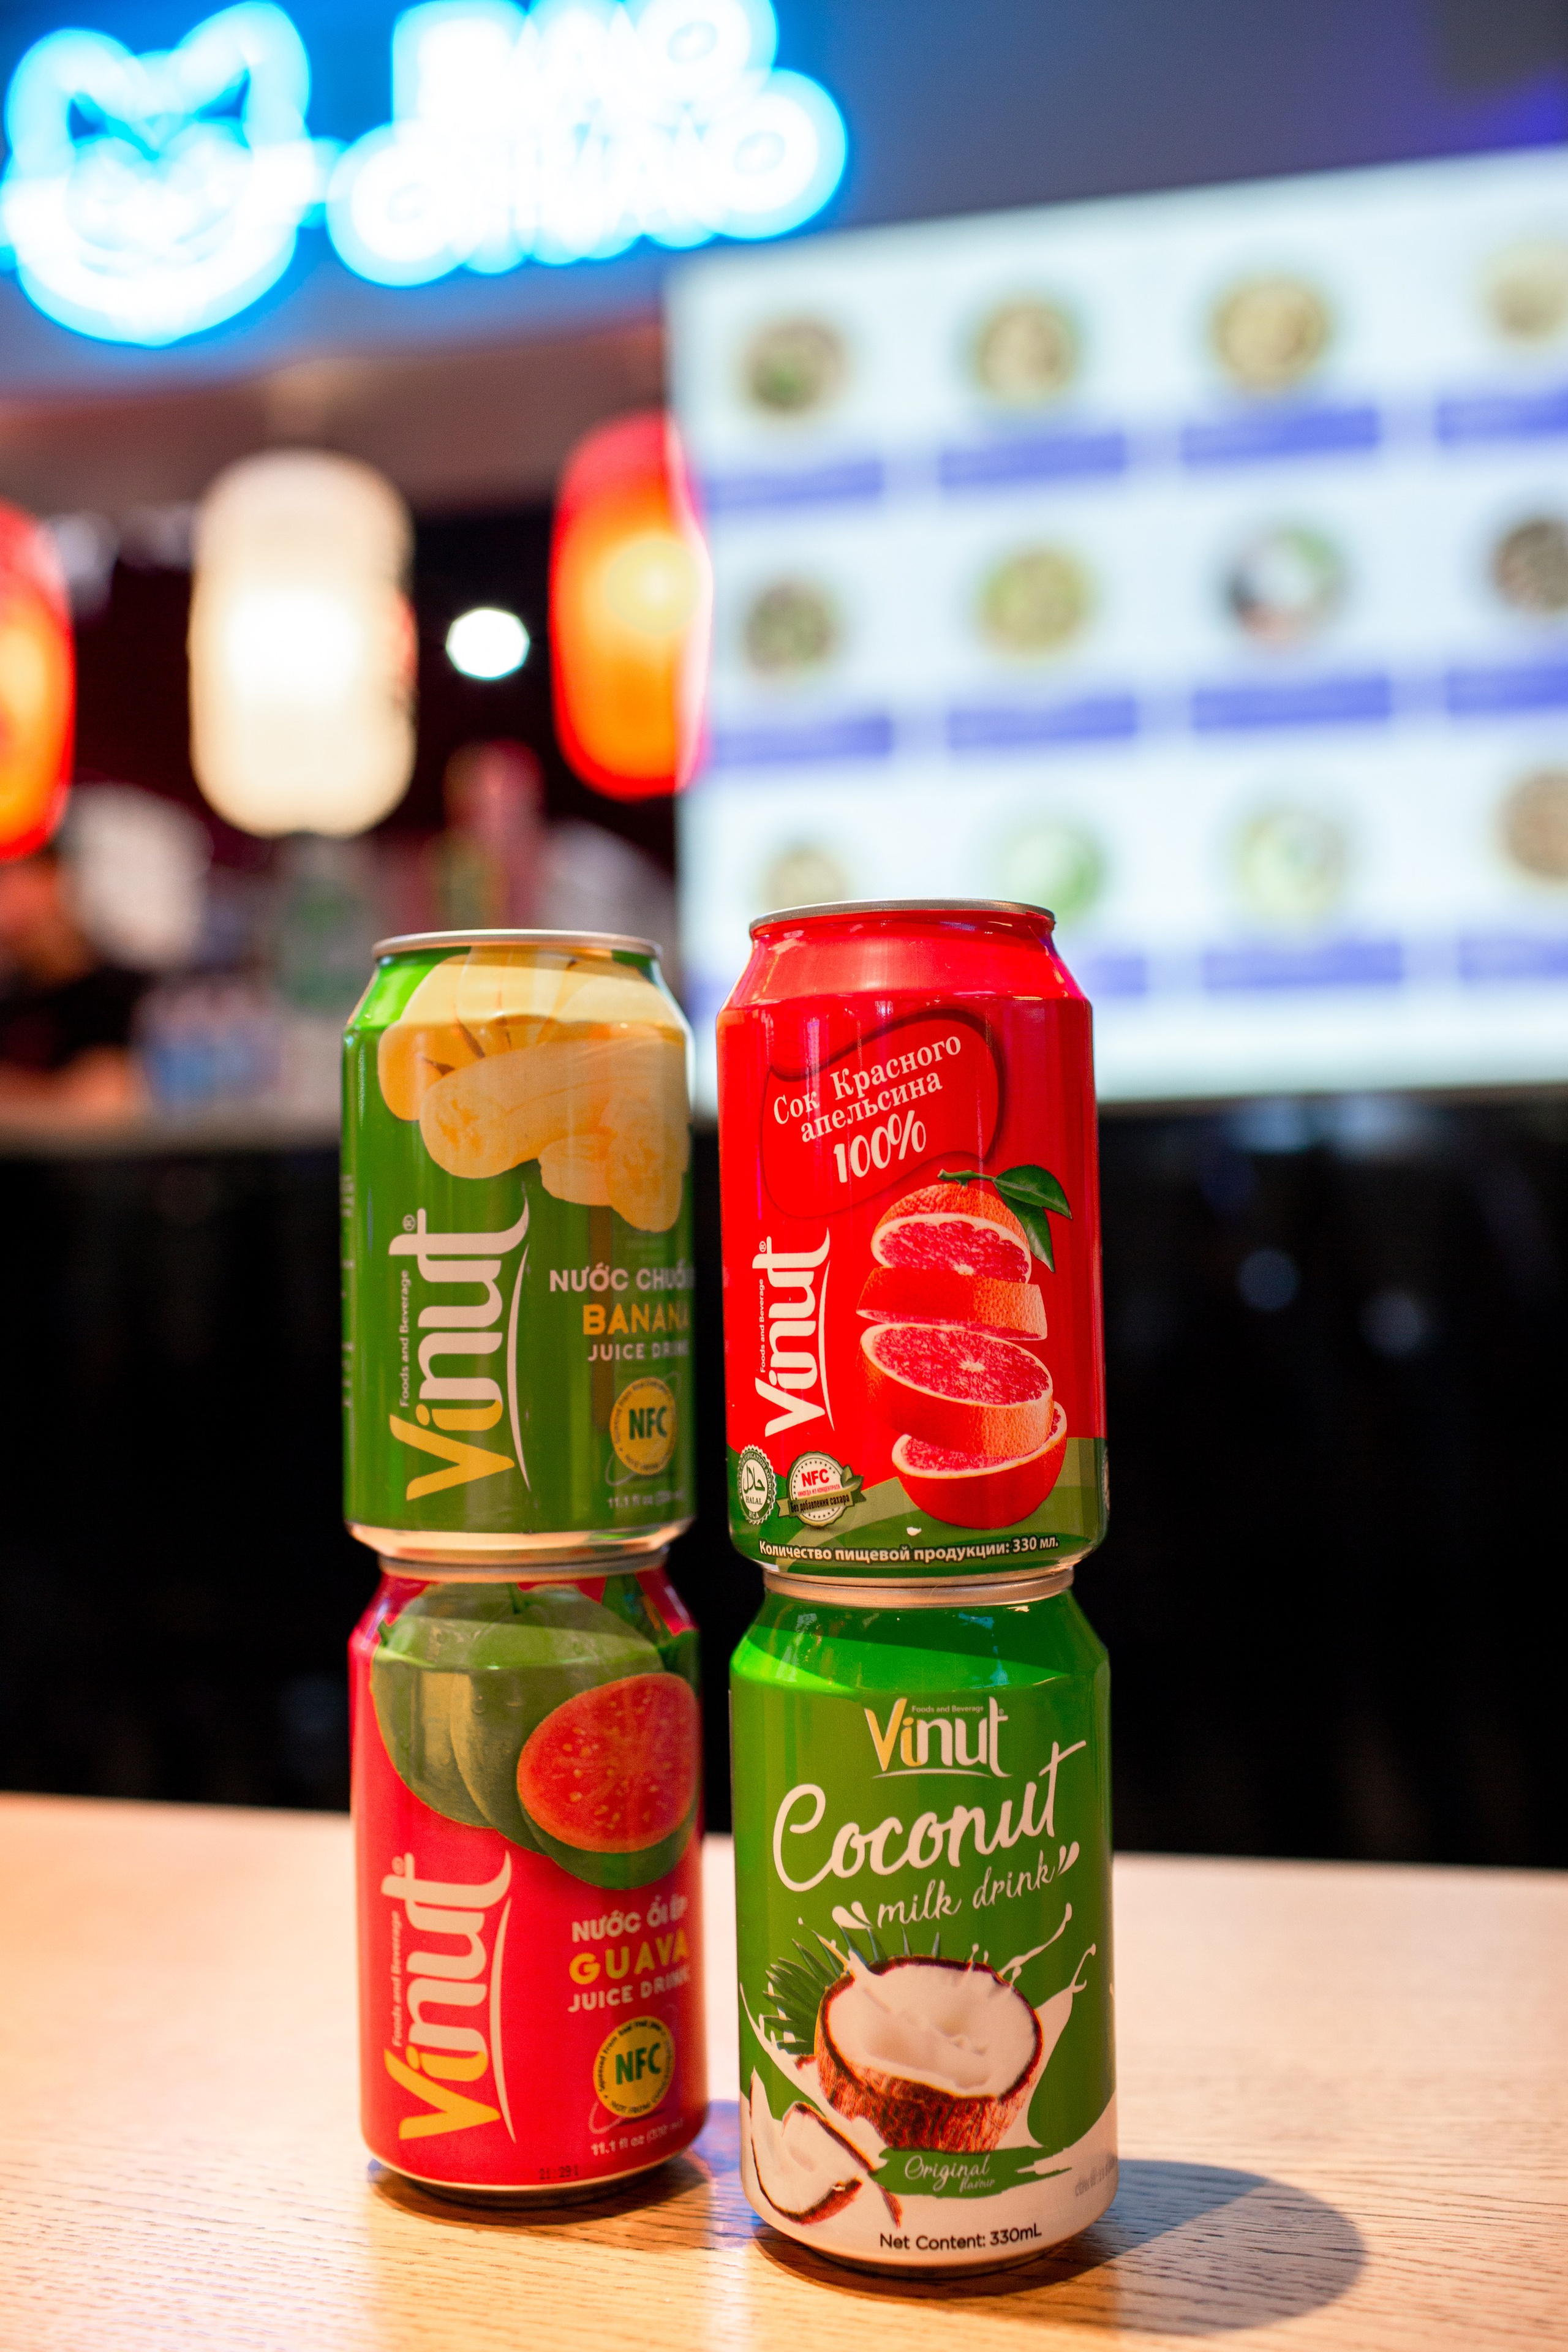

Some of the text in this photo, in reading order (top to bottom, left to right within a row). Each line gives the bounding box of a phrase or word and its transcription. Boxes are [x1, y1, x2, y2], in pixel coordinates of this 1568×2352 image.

[774, 1036, 961, 1125] Сок Красного
[801, 1072, 943, 1143] апельсина
[834, 1110, 927, 1183] 100%
[549, 1262, 628, 1292] NƯỚC
[388, 1182, 529, 1501] Vinut
[399, 1270, 411, 1407] Foods and Beverage
[588, 1343, 645, 1362] JUICE
[752, 1227, 831, 1437] Vinut
[629, 1406, 668, 1440] NFC
[745, 1496, 763, 1505] HALAL
[791, 1494, 850, 1513] Без добавления сахара
[801, 1468, 829, 1487] NFC
[759, 1536, 1059, 1563] Количество пищевой продукции: 330 мл.
[864, 1696, 1012, 1777] Vinut
[772, 1740, 1087, 1892] Coconut
[878, 1850, 1056, 1928] milk drink
[391, 1911, 403, 2047] Foods and Beverage
[569, 1928, 689, 1985] GUAVA
[380, 1850, 512, 2140] Vinut
[568, 1985, 634, 2013] JUICE
[616, 2043, 661, 2085] NFC
[904, 2153, 990, 2192] Original
[880, 2223, 1042, 2252] Net Content: 330mL
